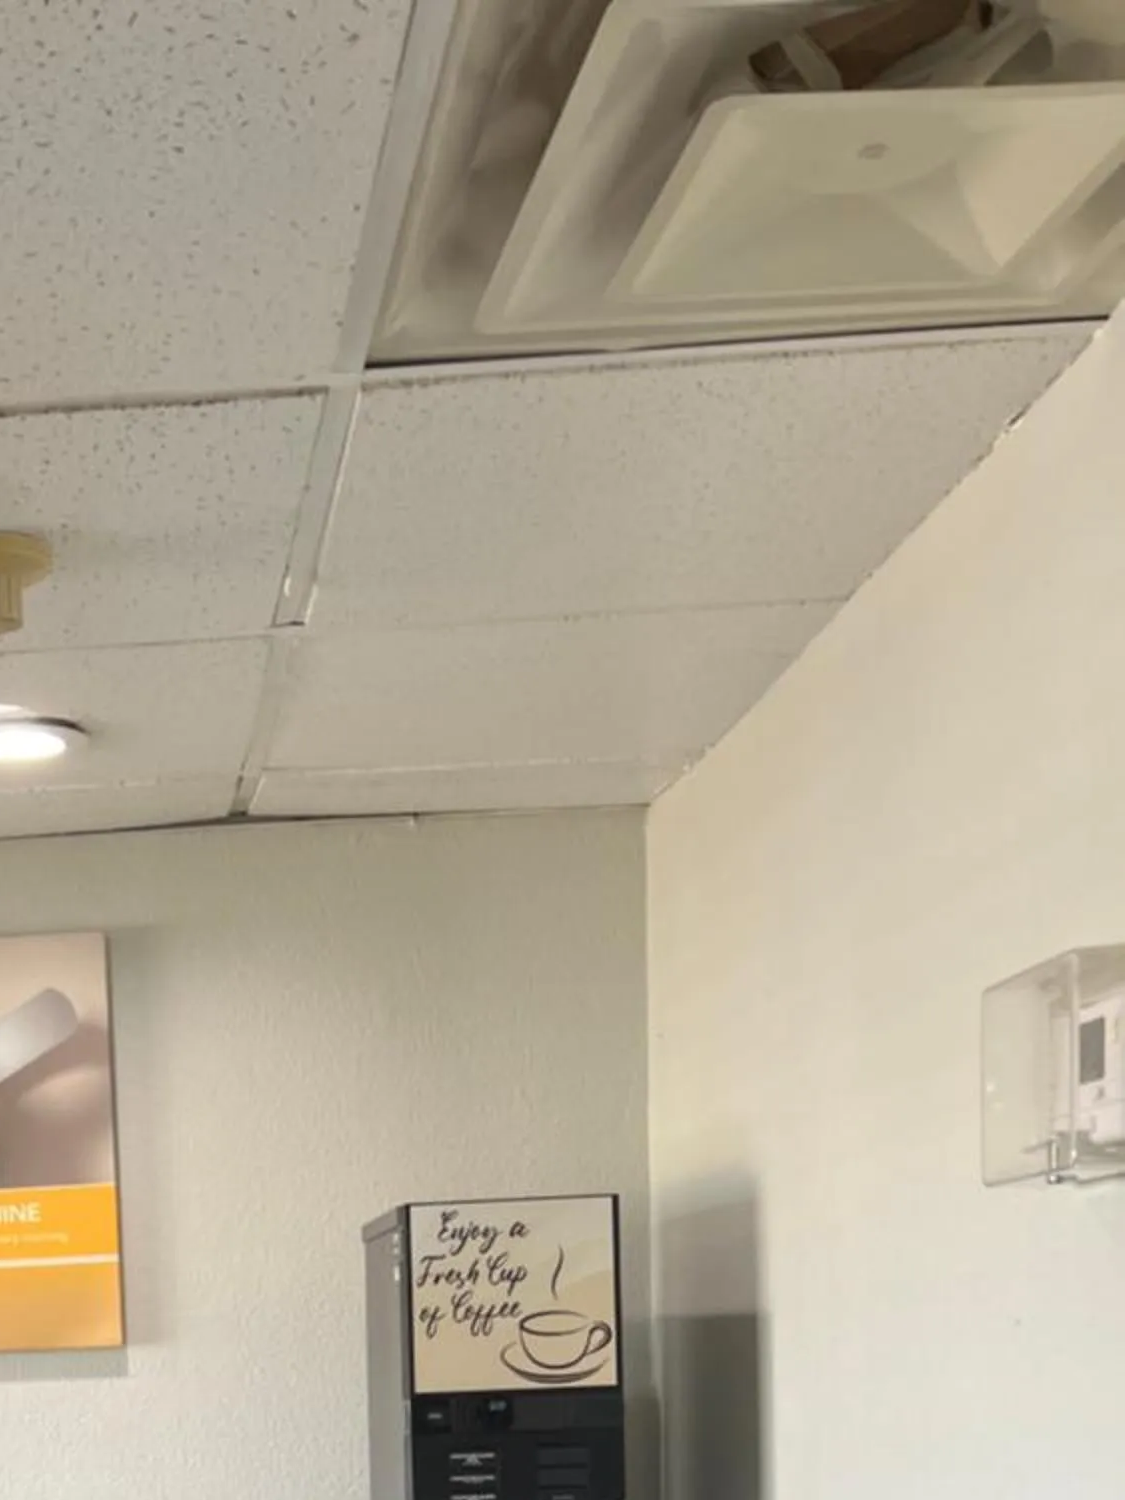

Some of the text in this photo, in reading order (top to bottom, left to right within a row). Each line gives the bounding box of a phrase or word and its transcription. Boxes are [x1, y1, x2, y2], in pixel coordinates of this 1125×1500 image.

[437, 1210, 529, 1255] Enjoy a
[416, 1251, 528, 1297] Fresh Cup
[419, 1290, 522, 1340] of Coffee
